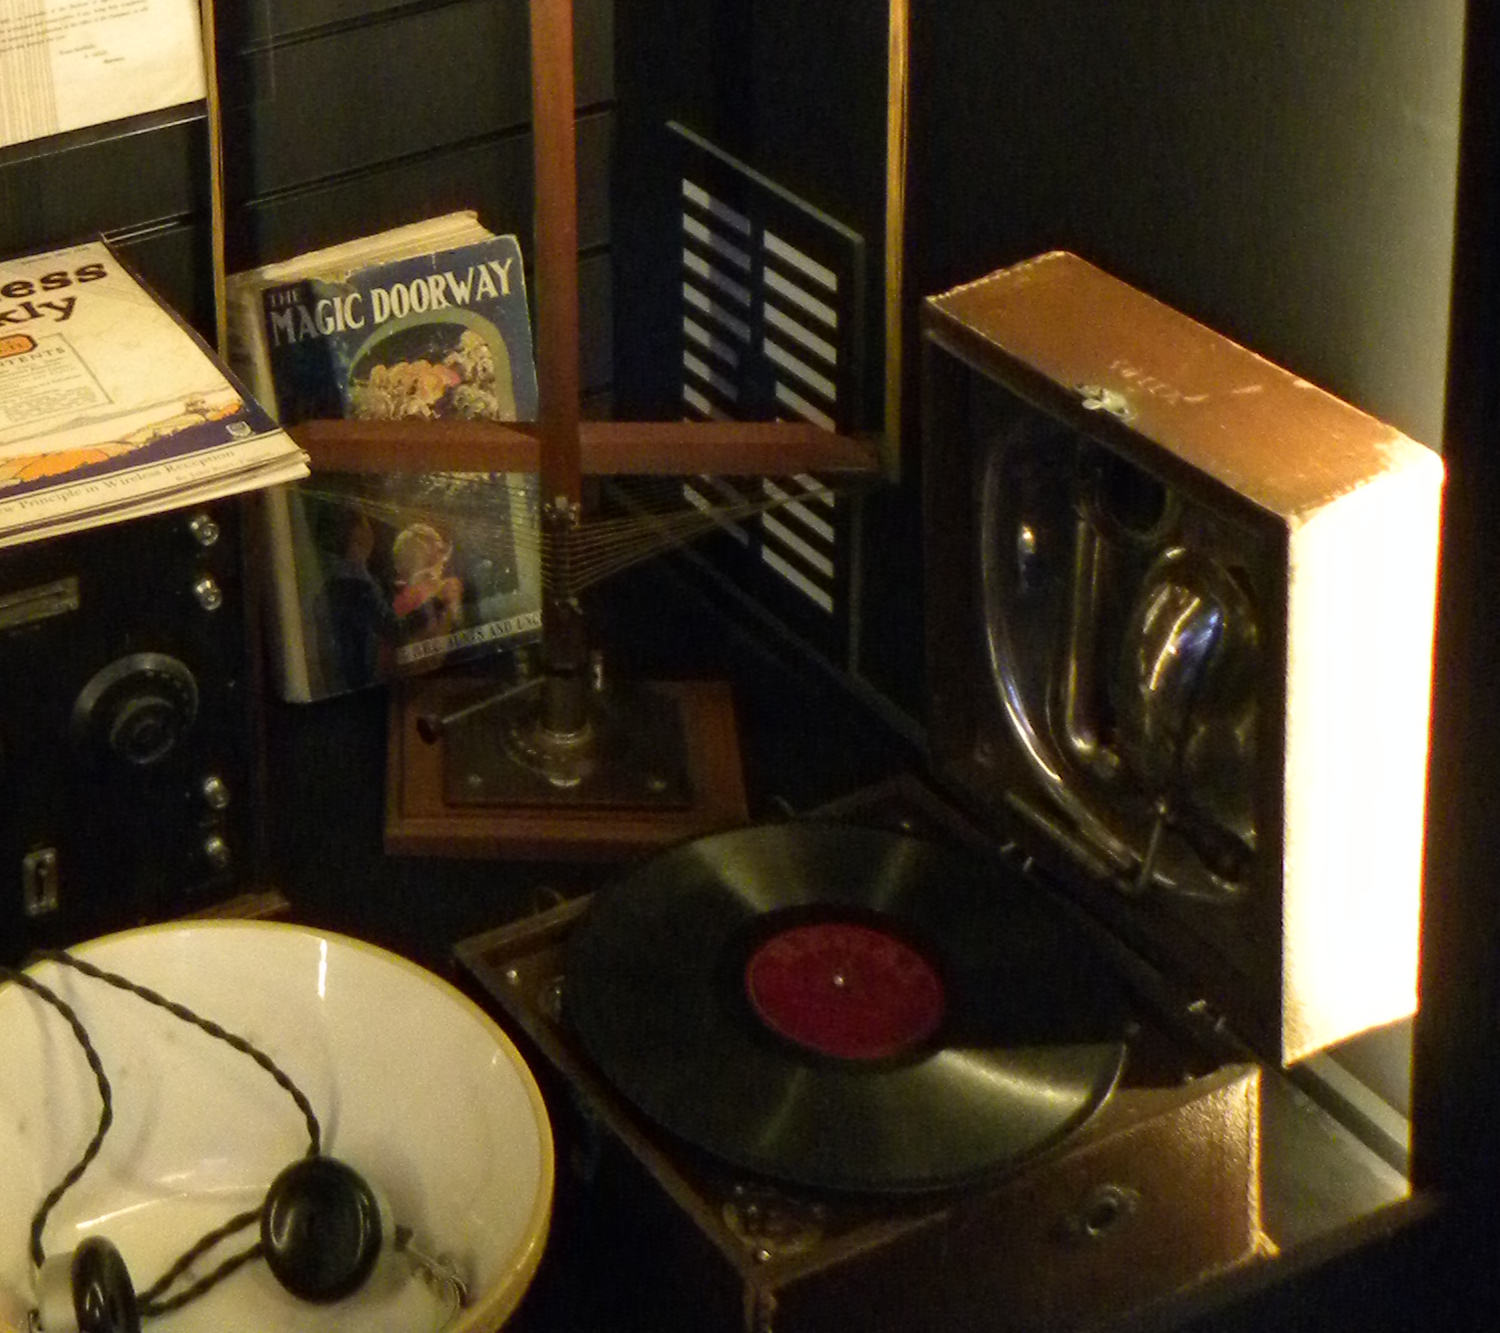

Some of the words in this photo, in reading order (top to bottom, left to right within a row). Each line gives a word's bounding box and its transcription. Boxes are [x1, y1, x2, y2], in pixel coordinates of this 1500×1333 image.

[270, 292, 365, 347] MAGIC
[370, 257, 513, 325] DOORWAY
[271, 289, 298, 307] THE
[18, 487, 83, 510] Principle
[102, 467, 161, 489] Wireless
[164, 449, 235, 473] Reception
